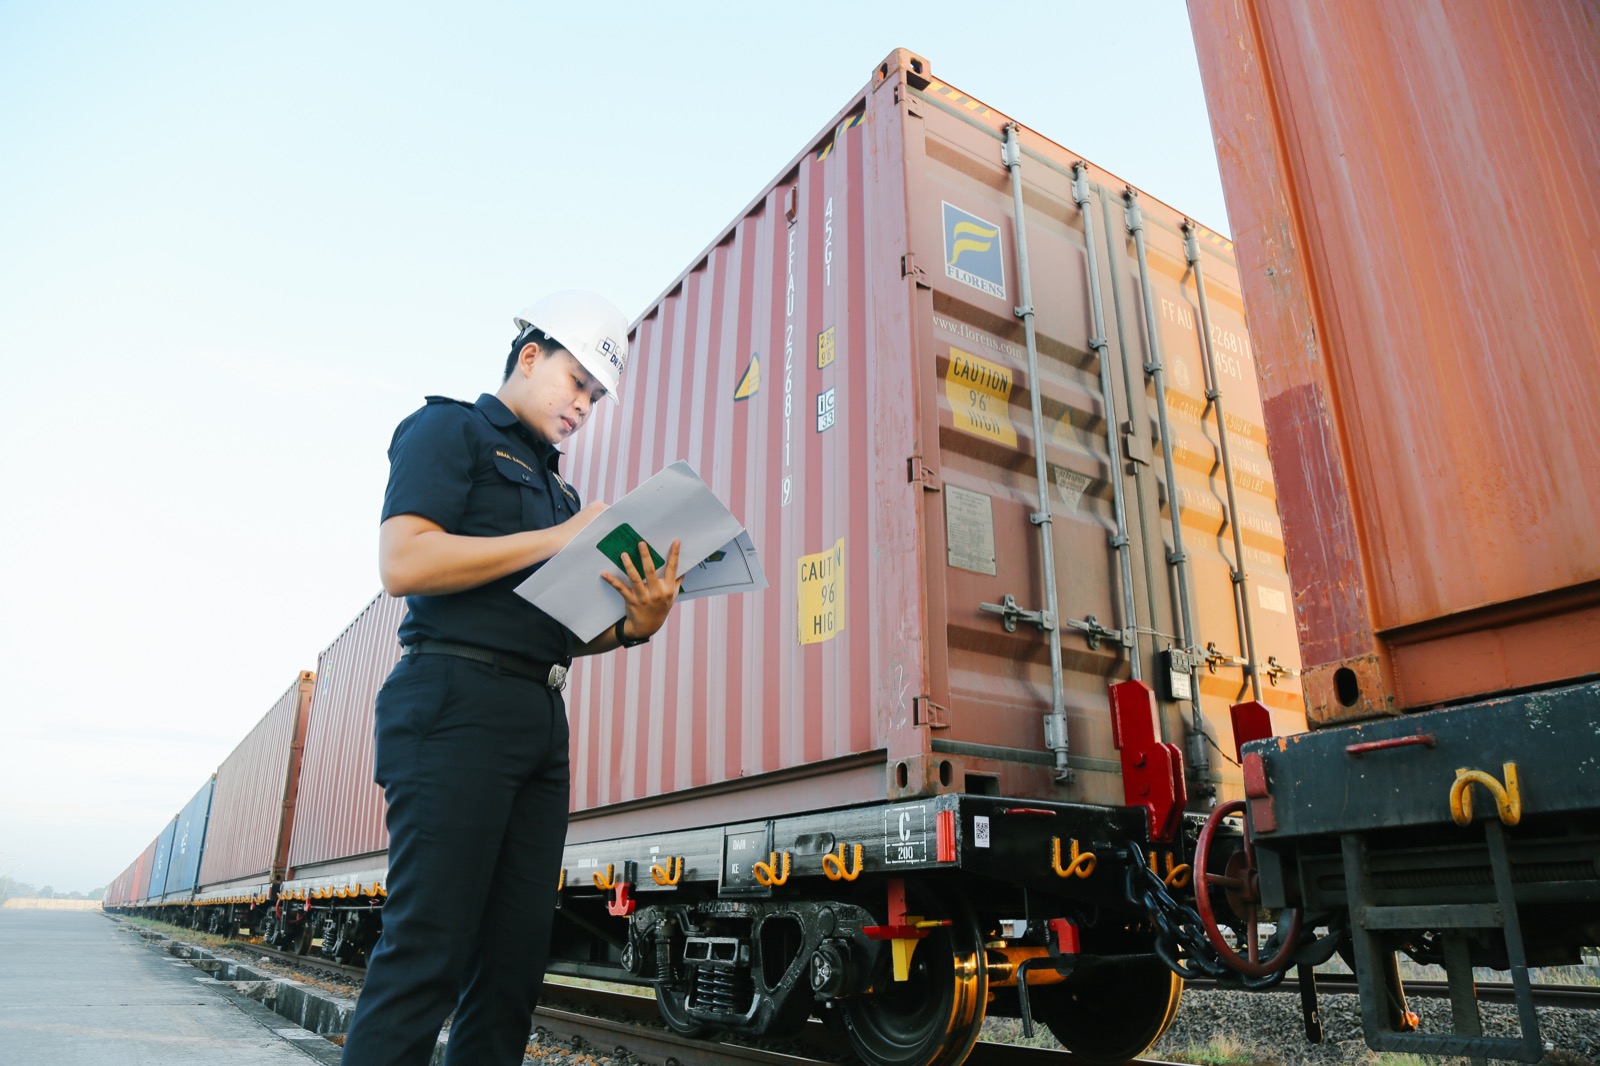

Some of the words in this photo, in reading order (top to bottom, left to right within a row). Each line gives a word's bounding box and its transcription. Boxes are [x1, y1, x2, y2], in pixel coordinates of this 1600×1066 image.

[825, 197, 833, 286] 45G1
[787, 230, 796, 317] FFAU
[947, 265, 1004, 298] FLORENS
[1162, 298, 1193, 330] FFAU
[953, 356, 1008, 394] CAUTION
[1215, 351, 1242, 381] 45G1
[784, 324, 793, 467] 226811
[968, 409, 1000, 435] HIGH
[801, 546, 841, 583] CAUTN
[813, 611, 836, 635] HIG
[899, 811, 911, 841] C
[898, 845, 914, 860] 200
